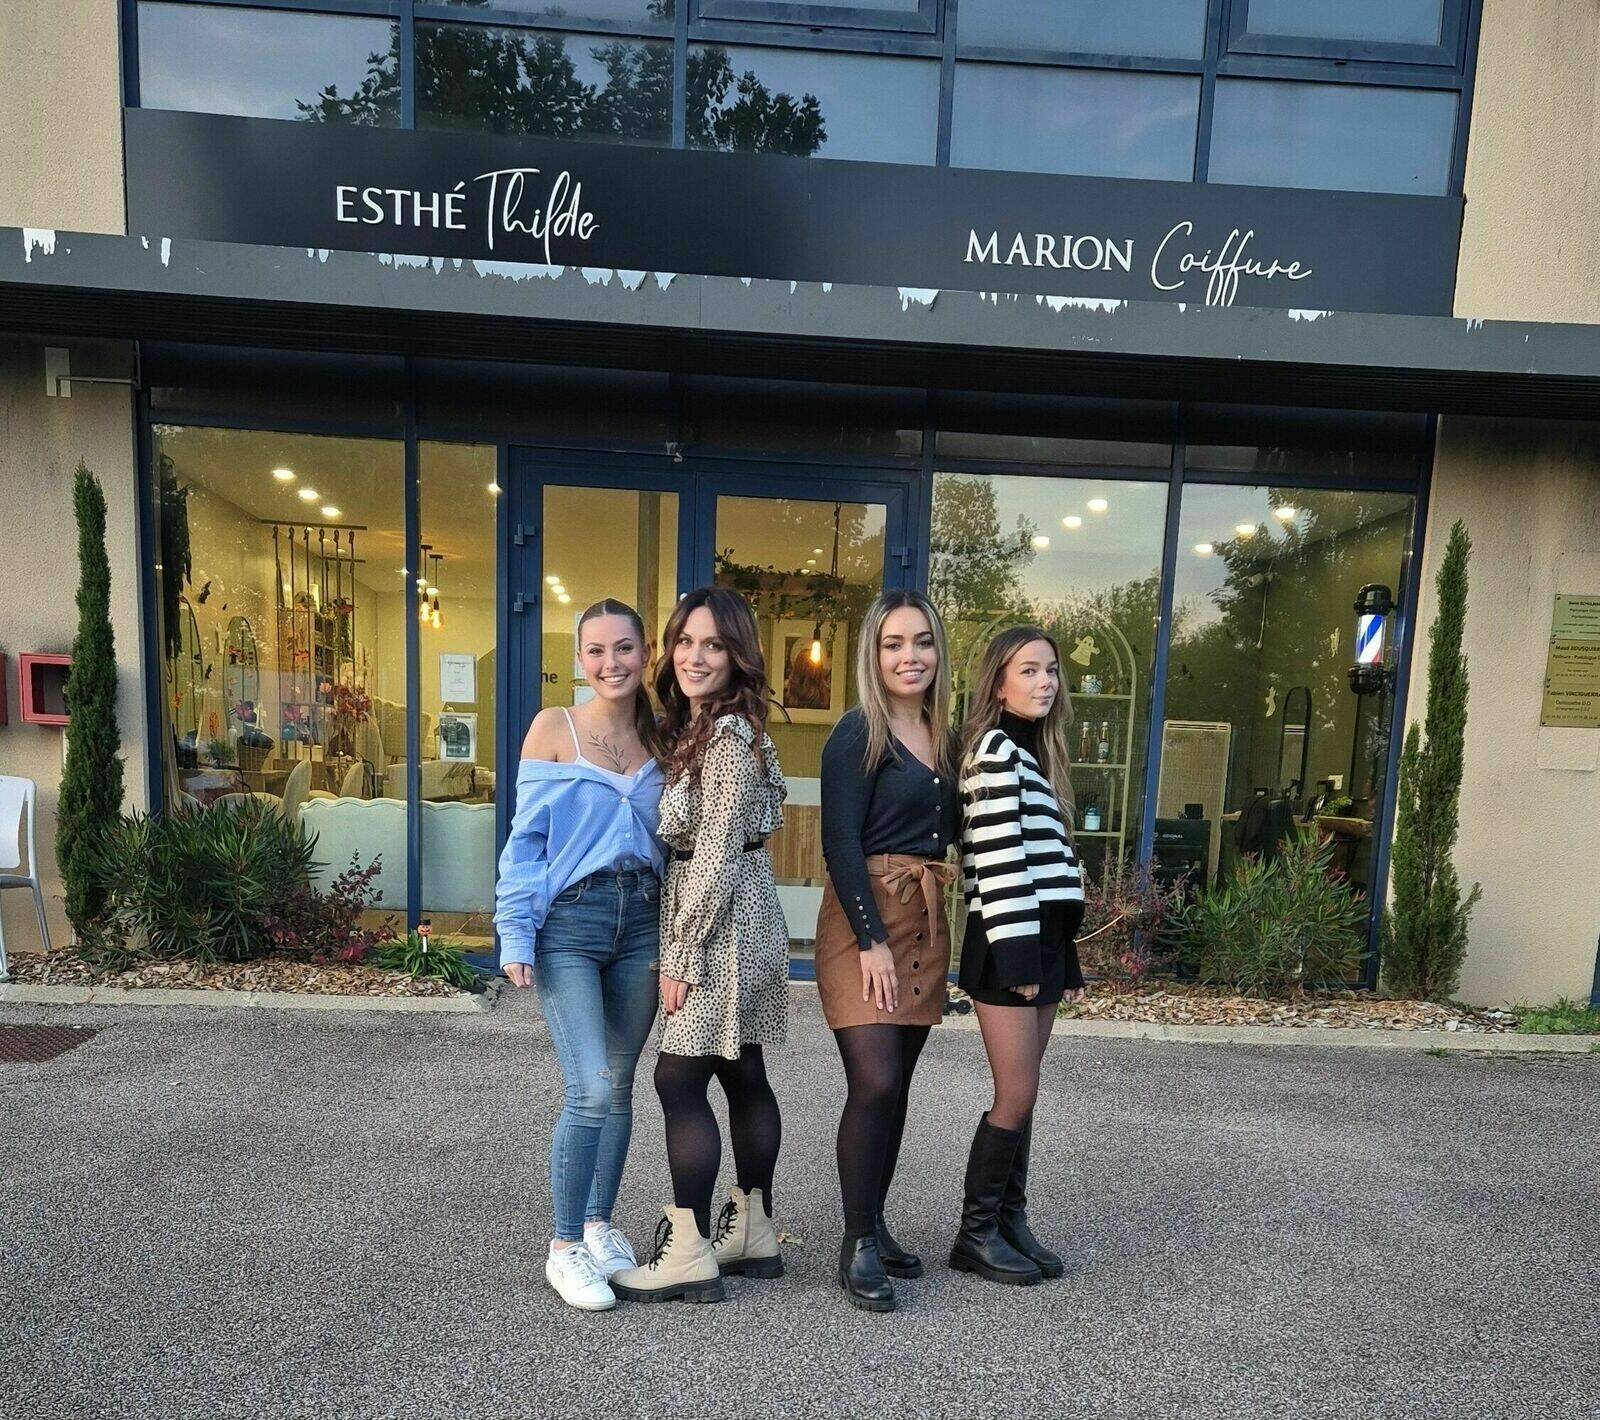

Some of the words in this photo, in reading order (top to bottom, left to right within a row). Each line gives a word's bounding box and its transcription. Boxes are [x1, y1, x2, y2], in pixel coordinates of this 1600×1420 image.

[336, 181, 467, 230] ESTHÉ
[473, 168, 600, 265] Thilde
[964, 229, 1135, 272] MARION
[1151, 221, 1312, 307] Coiffure
